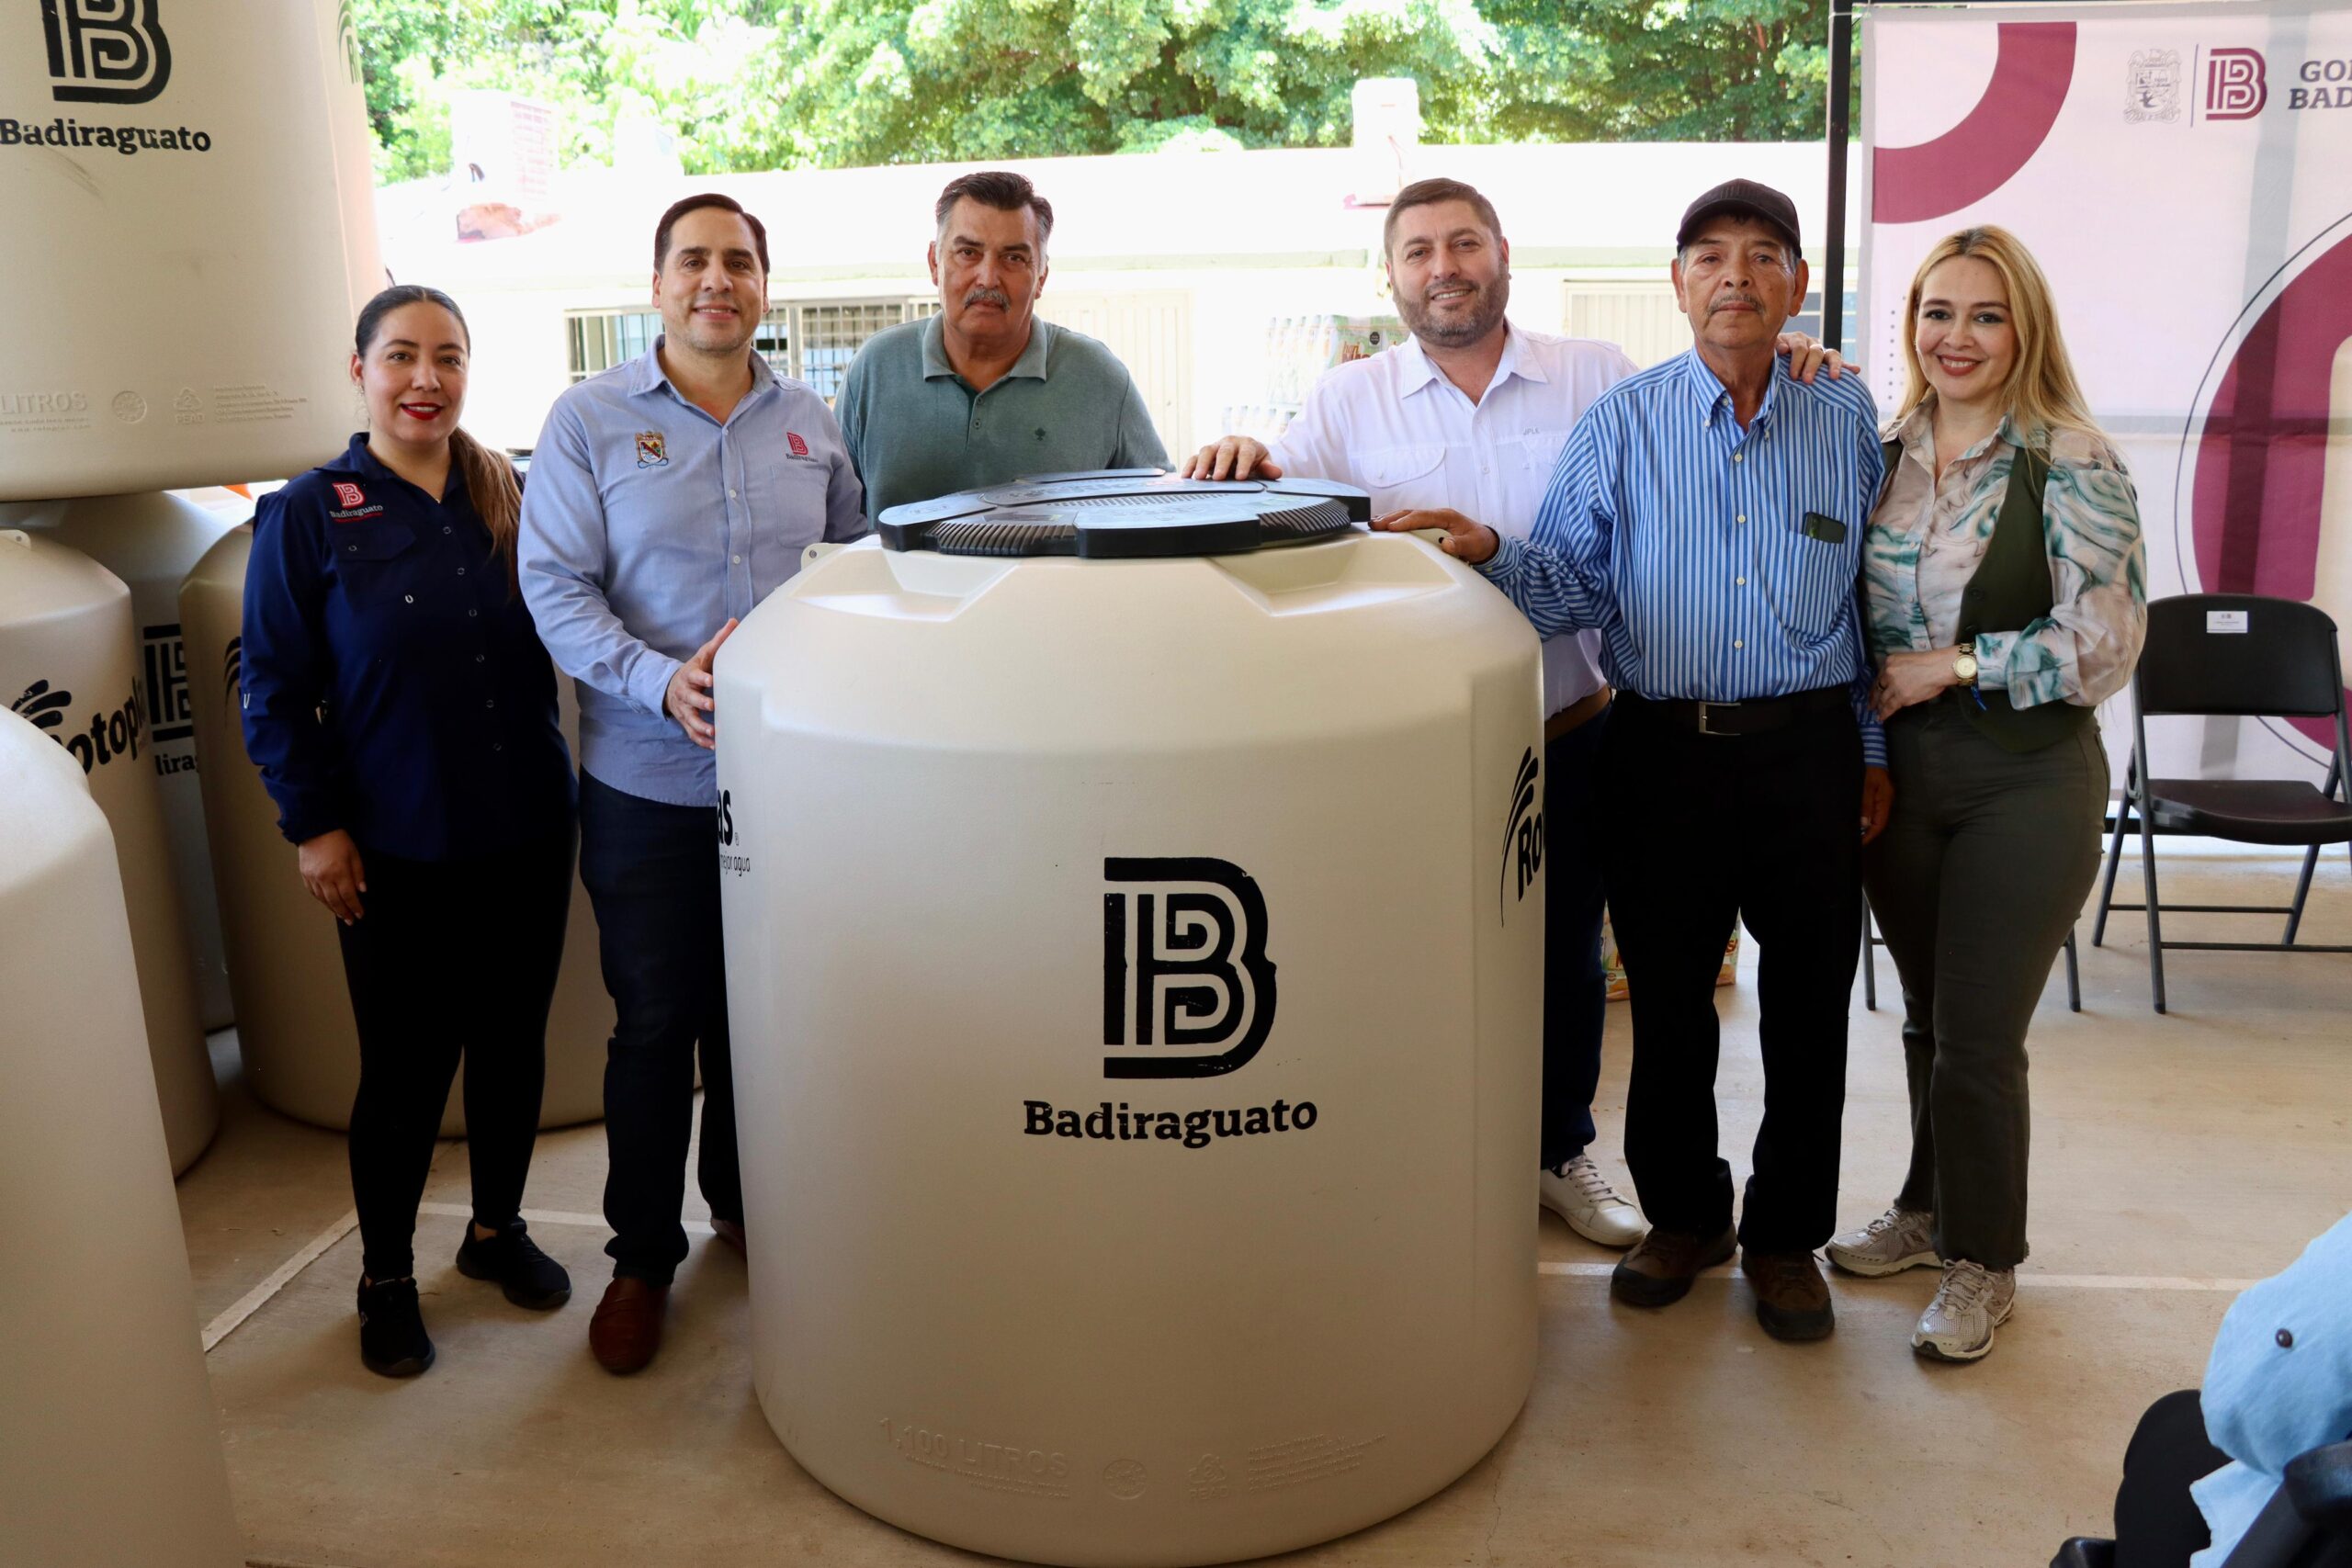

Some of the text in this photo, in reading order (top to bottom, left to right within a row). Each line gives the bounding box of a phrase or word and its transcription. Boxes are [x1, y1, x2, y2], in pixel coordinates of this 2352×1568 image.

[2205, 48, 2267, 120] B
[2300, 60, 2352, 83] GO
[0, 118, 211, 155] Badiraguato
[329, 504, 384, 518] Badiraguato
[332, 481, 367, 509] B
[1103, 856, 1277, 1079] B
[1023, 1099, 1318, 1149] Badiraguato
